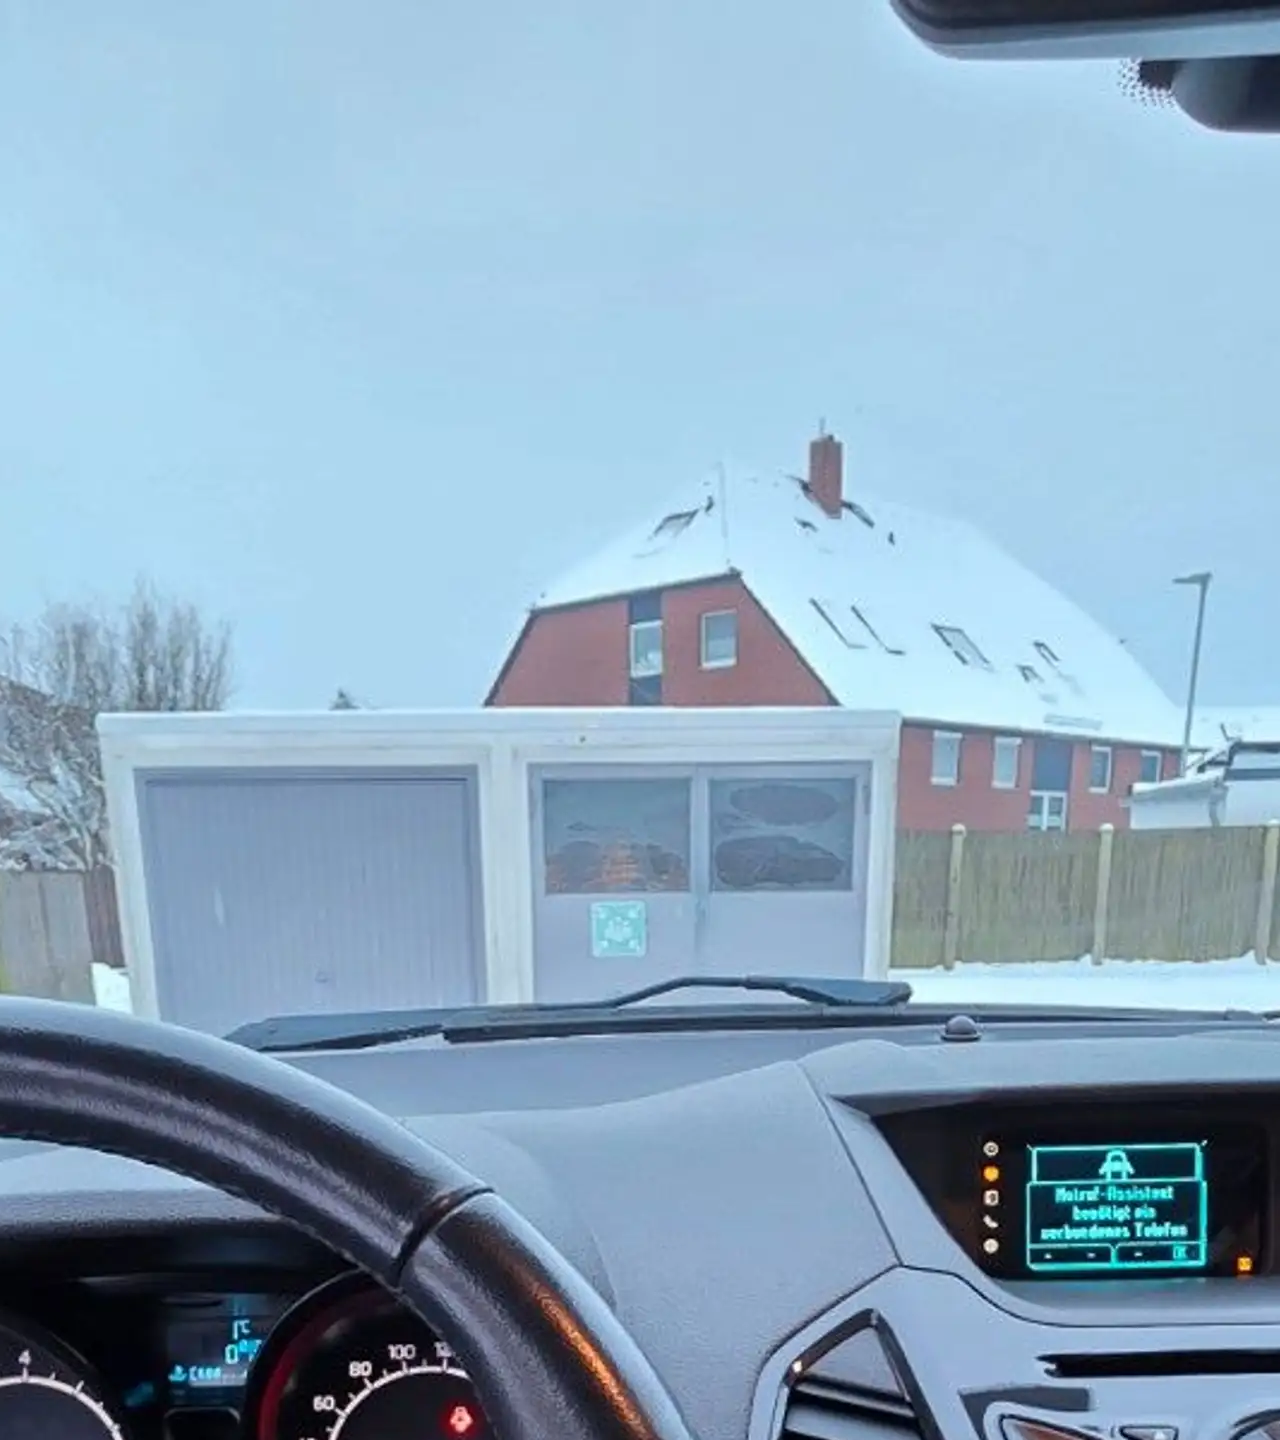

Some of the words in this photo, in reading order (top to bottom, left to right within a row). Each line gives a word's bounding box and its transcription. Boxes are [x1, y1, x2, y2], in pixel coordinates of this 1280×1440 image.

[1134, 1222, 1188, 1238] Telefon
[19, 1350, 31, 1365] 4
[388, 1344, 416, 1360] 100
[349, 1361, 373, 1378] 80
[313, 1395, 336, 1411] 60
